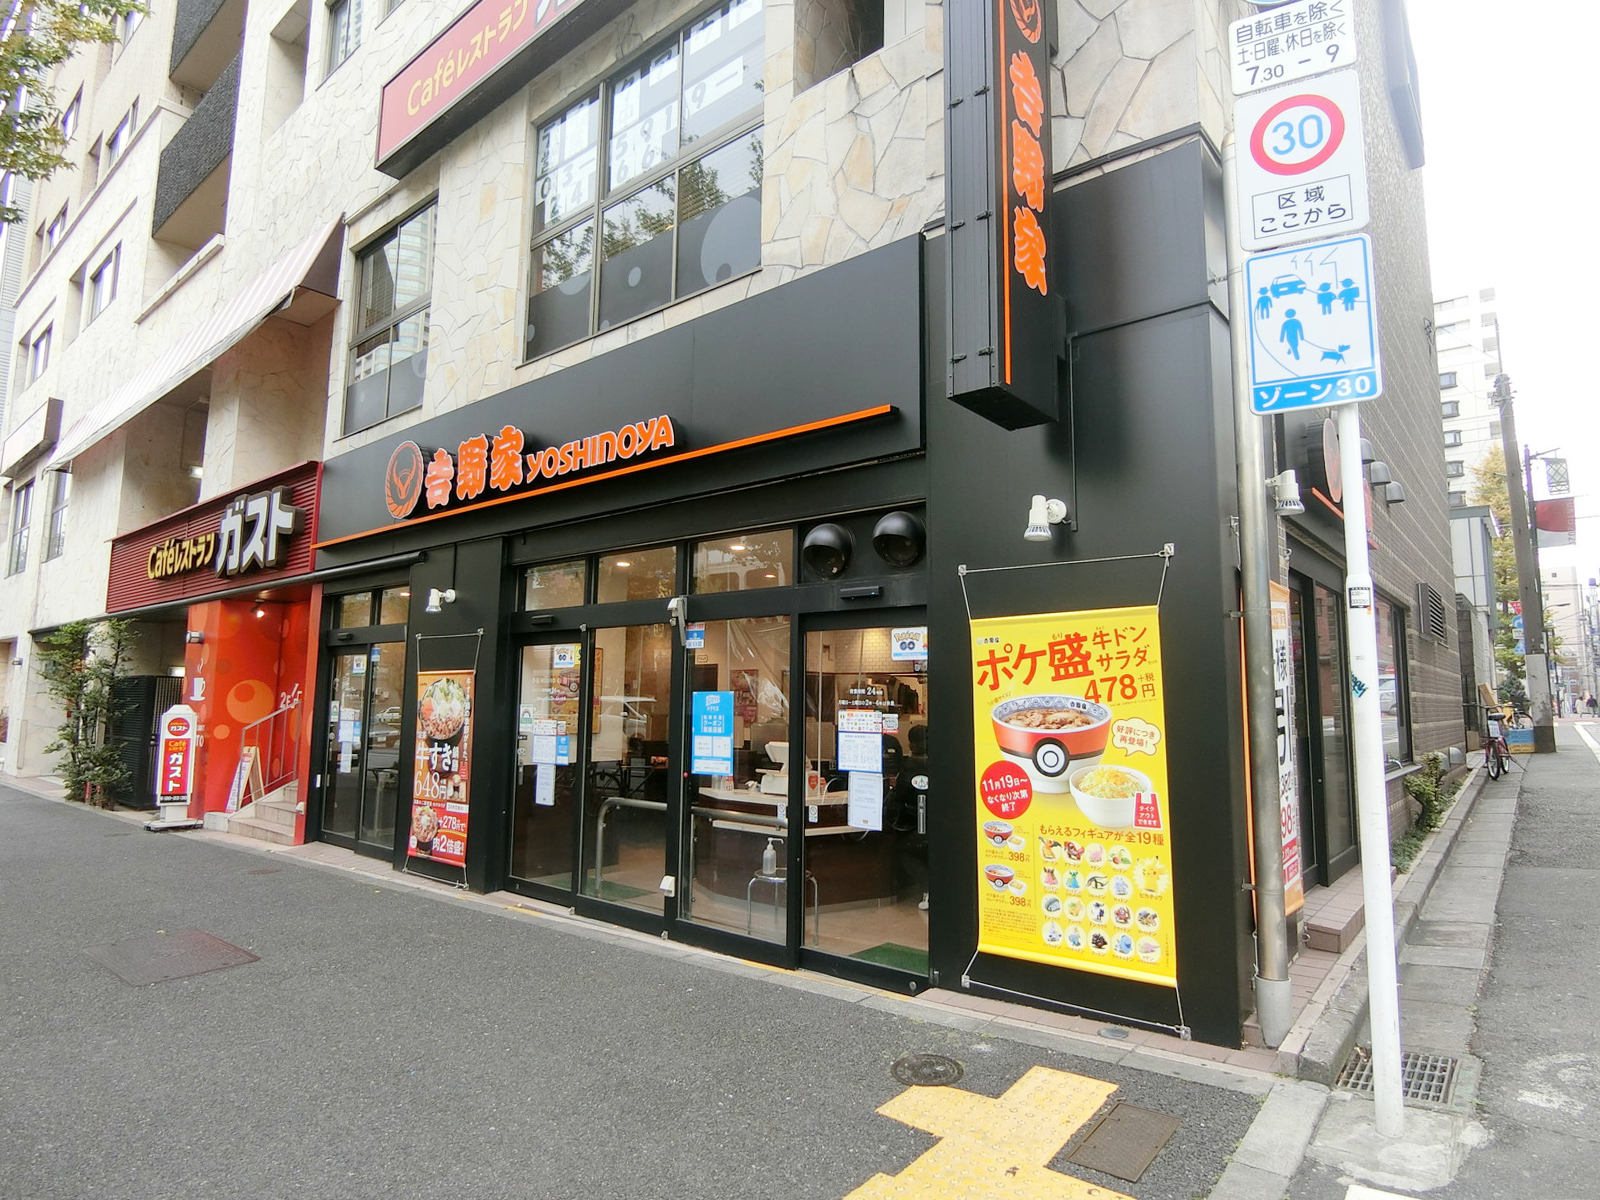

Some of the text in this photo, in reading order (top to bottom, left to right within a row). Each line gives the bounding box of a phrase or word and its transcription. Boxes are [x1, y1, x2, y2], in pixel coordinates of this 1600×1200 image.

[1237, 0, 1344, 43] 自転車を除く
[1272, 114, 1324, 155] 30
[1278, 185, 1325, 209] 区域
[1261, 203, 1347, 233] ここから
[1260, 375, 1371, 408] ゾーン30
[527, 414, 675, 483] YOSHINOYA
[215, 488, 295, 577] ガスト
[1092, 626, 1147, 651] 牛ドン
[977, 631, 1094, 691] ポケ盛
[1096, 644, 1150, 672] サラダ
[168, 752, 184, 792] ガスト
[987, 789, 1029, 804] なくなり次第
[1001, 801, 1016, 812] 終了
